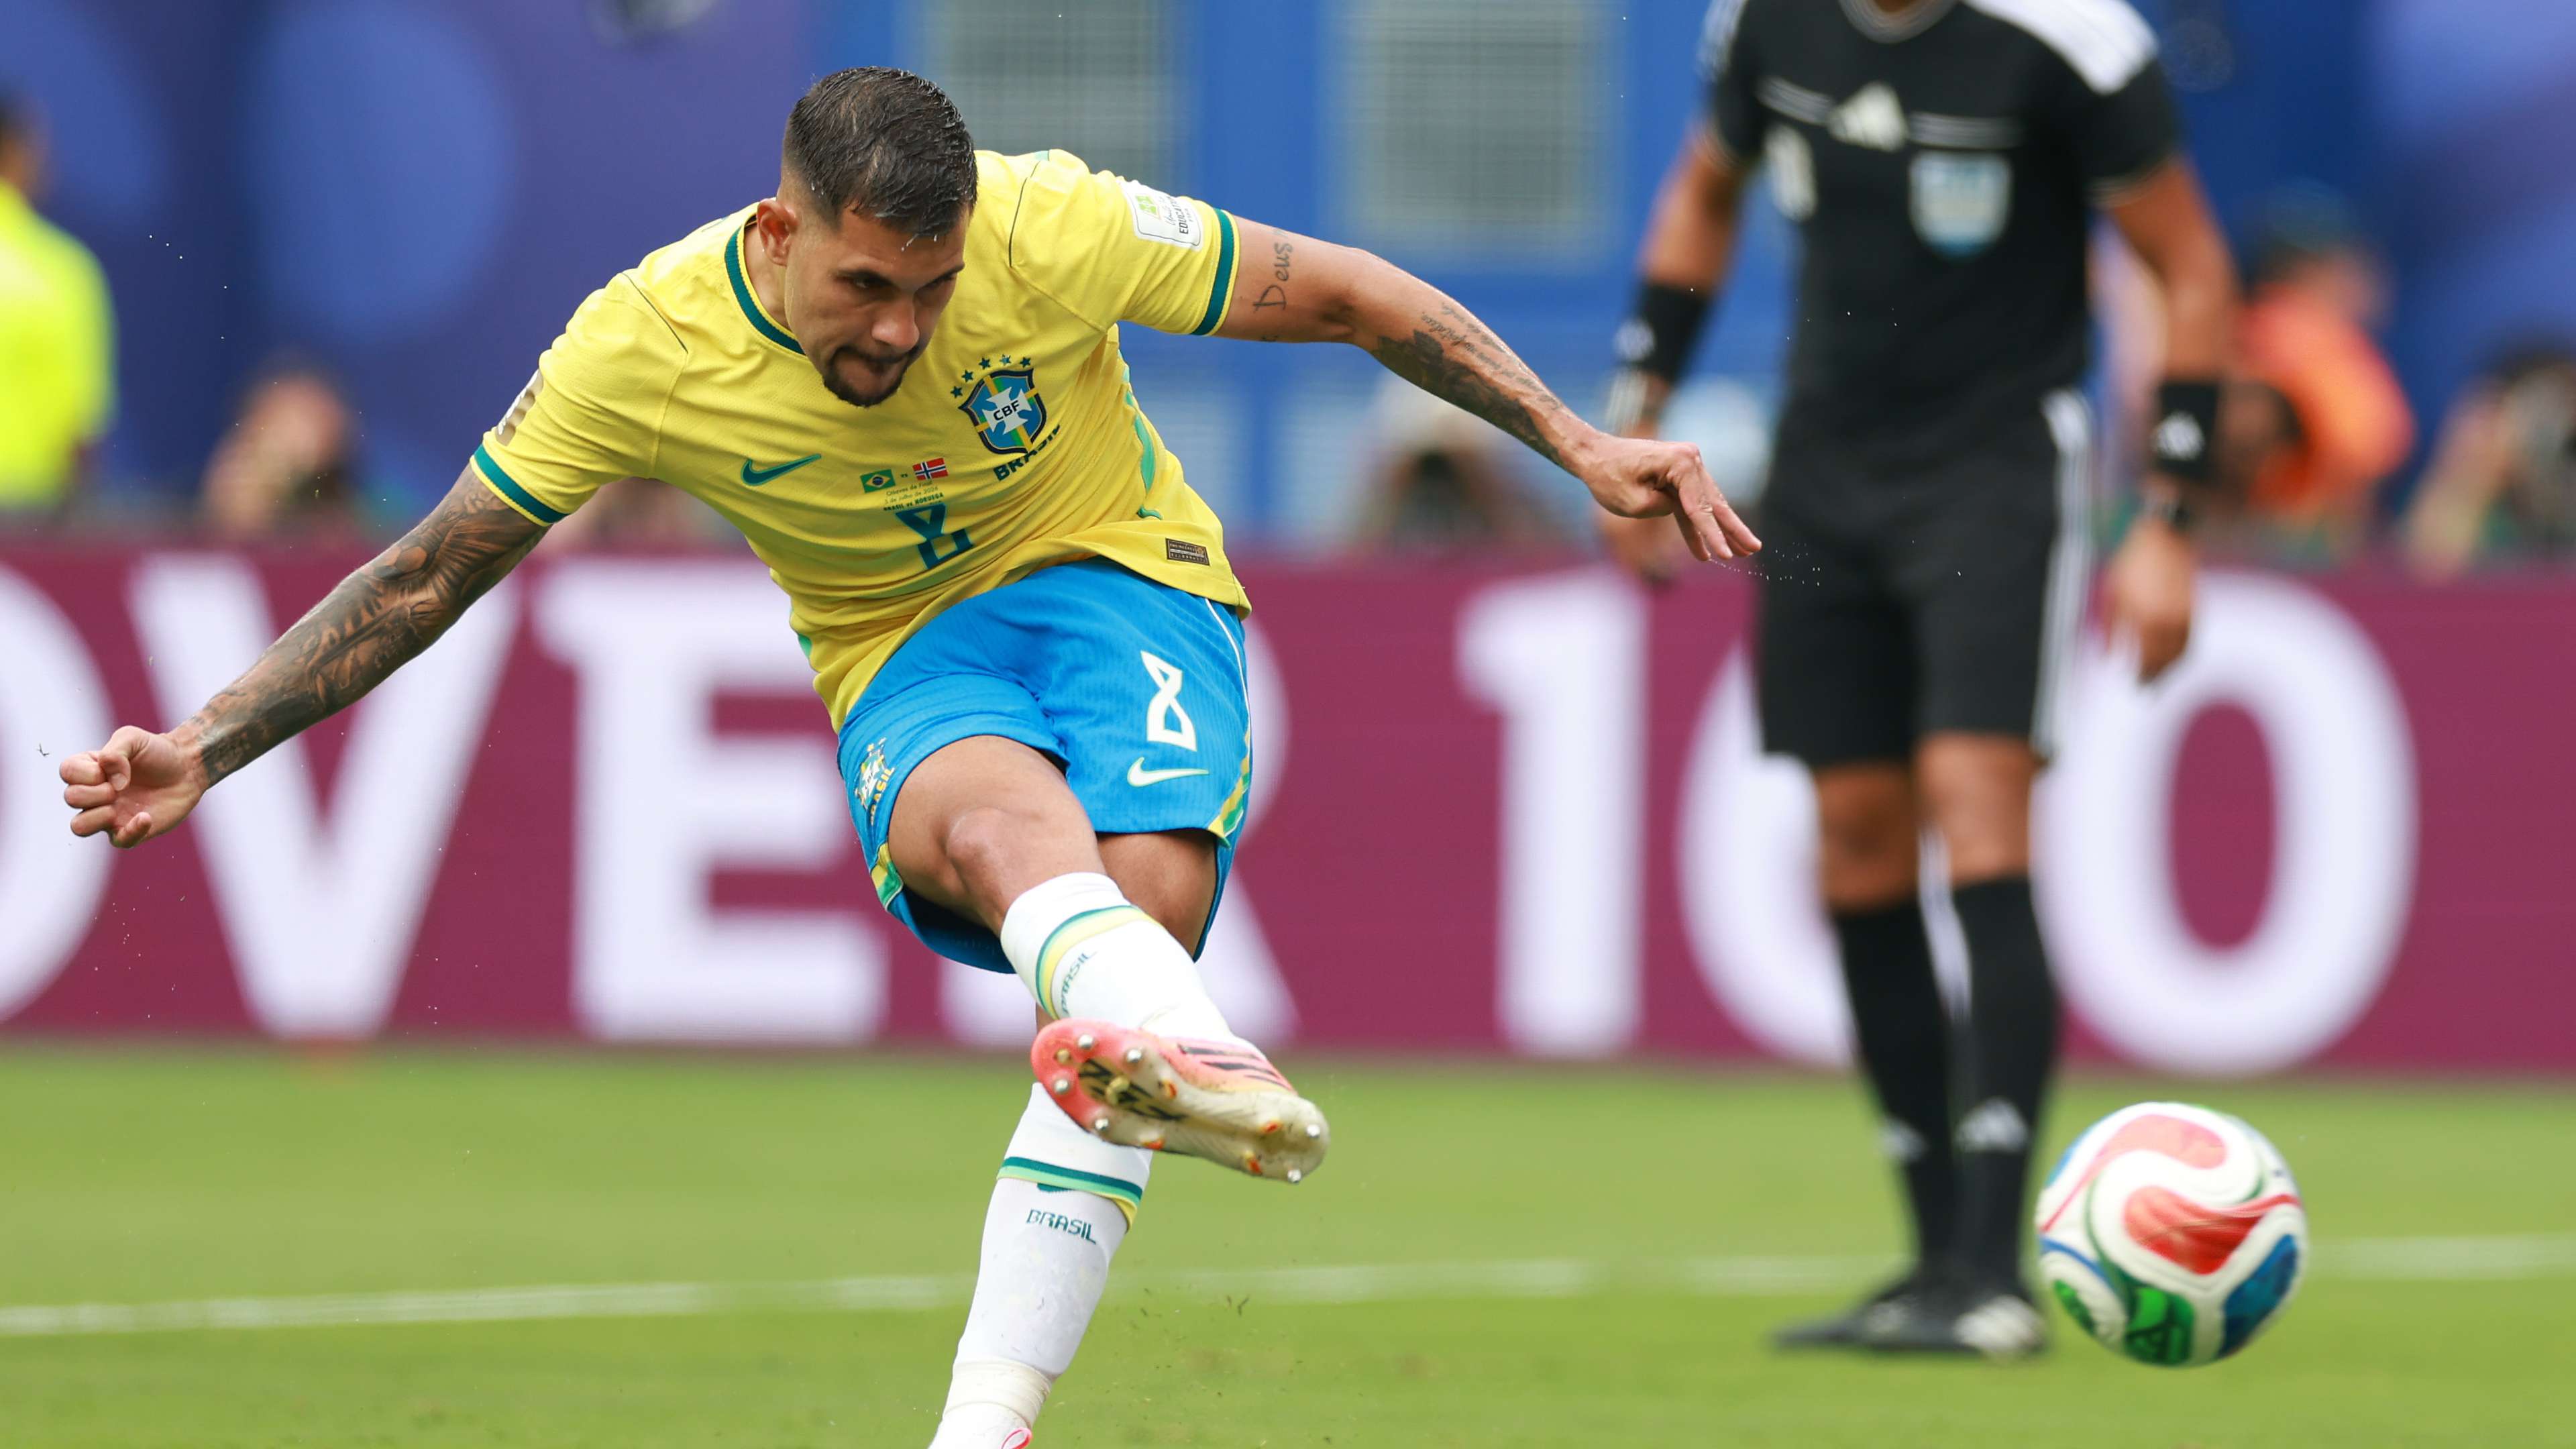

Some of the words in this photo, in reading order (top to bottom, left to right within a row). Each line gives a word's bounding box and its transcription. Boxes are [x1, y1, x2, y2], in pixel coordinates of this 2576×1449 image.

[1252, 242, 1293, 313] Deus
[993, 400, 1020, 421] CBF
[1140, 649, 1197, 752] 8
[1026, 1209, 1096, 1245] BRASIL
